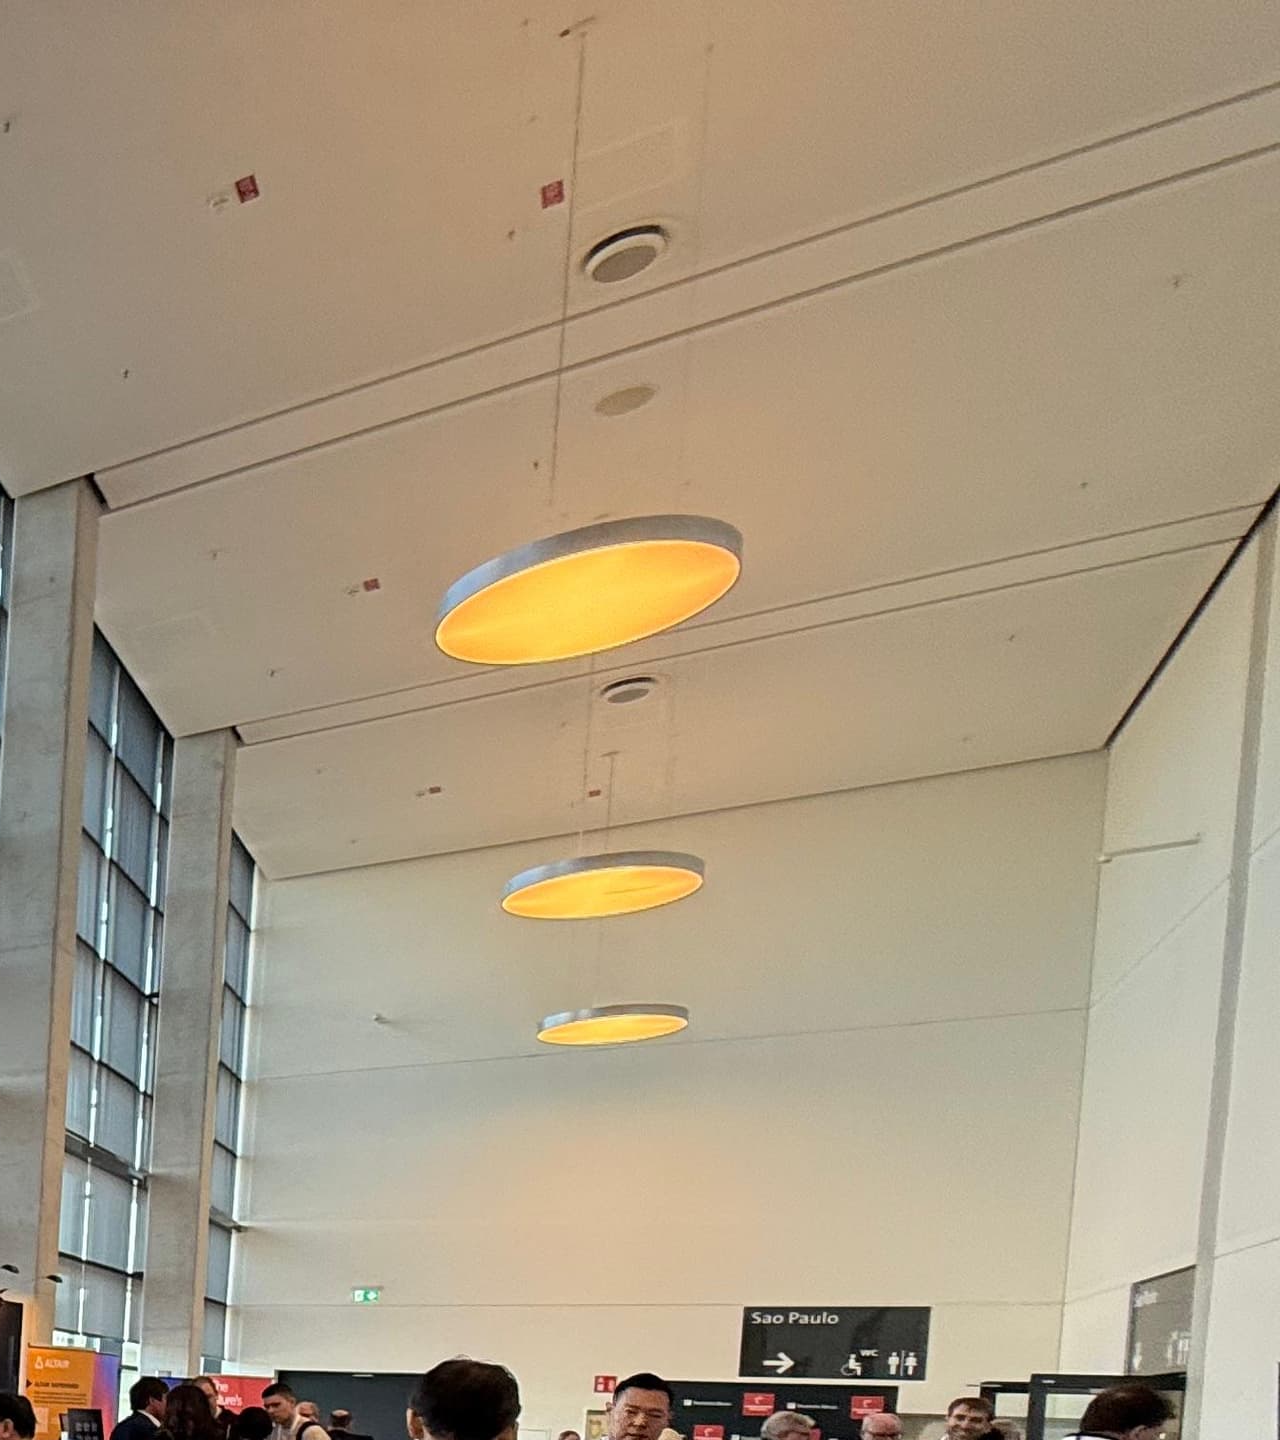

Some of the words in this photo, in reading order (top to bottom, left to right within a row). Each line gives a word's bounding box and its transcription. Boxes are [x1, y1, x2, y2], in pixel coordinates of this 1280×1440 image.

[751, 1311, 785, 1325] Sao
[788, 1311, 839, 1325] Paulo
[859, 1349, 879, 1357] WC
